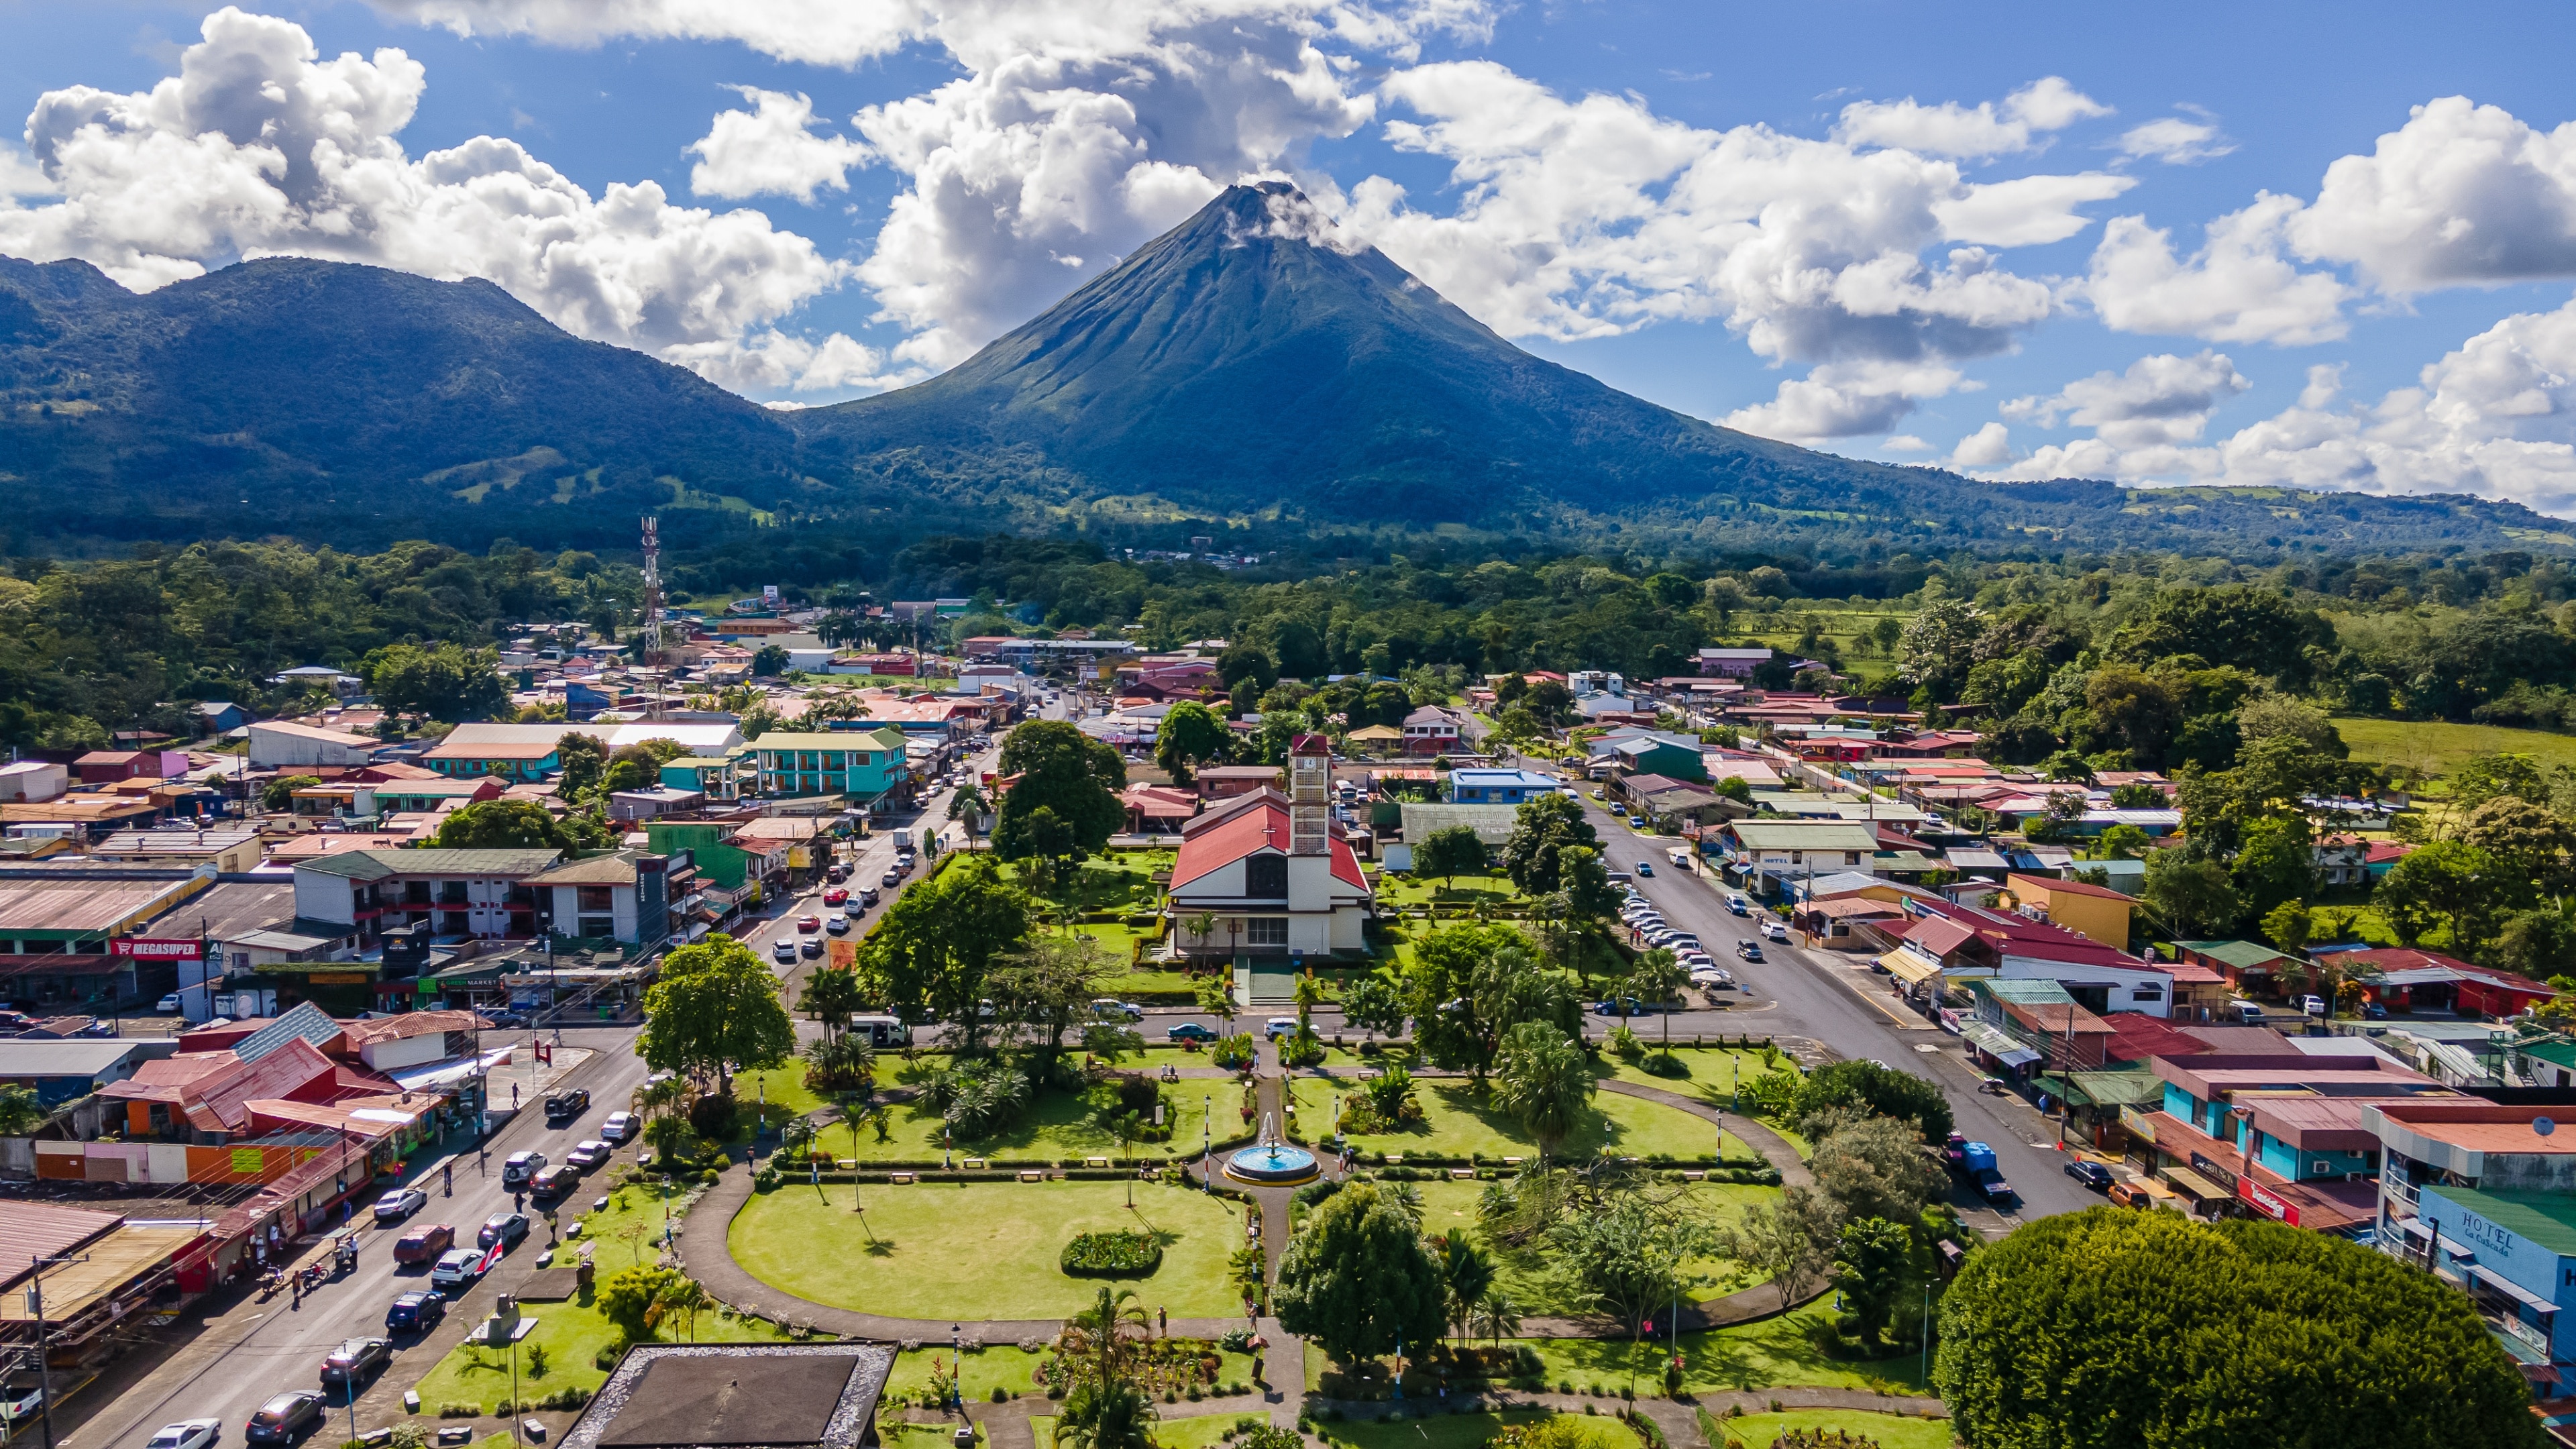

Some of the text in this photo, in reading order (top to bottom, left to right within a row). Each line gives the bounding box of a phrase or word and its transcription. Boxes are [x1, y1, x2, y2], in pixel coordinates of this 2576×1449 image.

[133, 943, 196, 955] MEGASUPER
[2462, 1212, 2513, 1249] HOTEL
[2465, 1228, 2474, 1238] La
